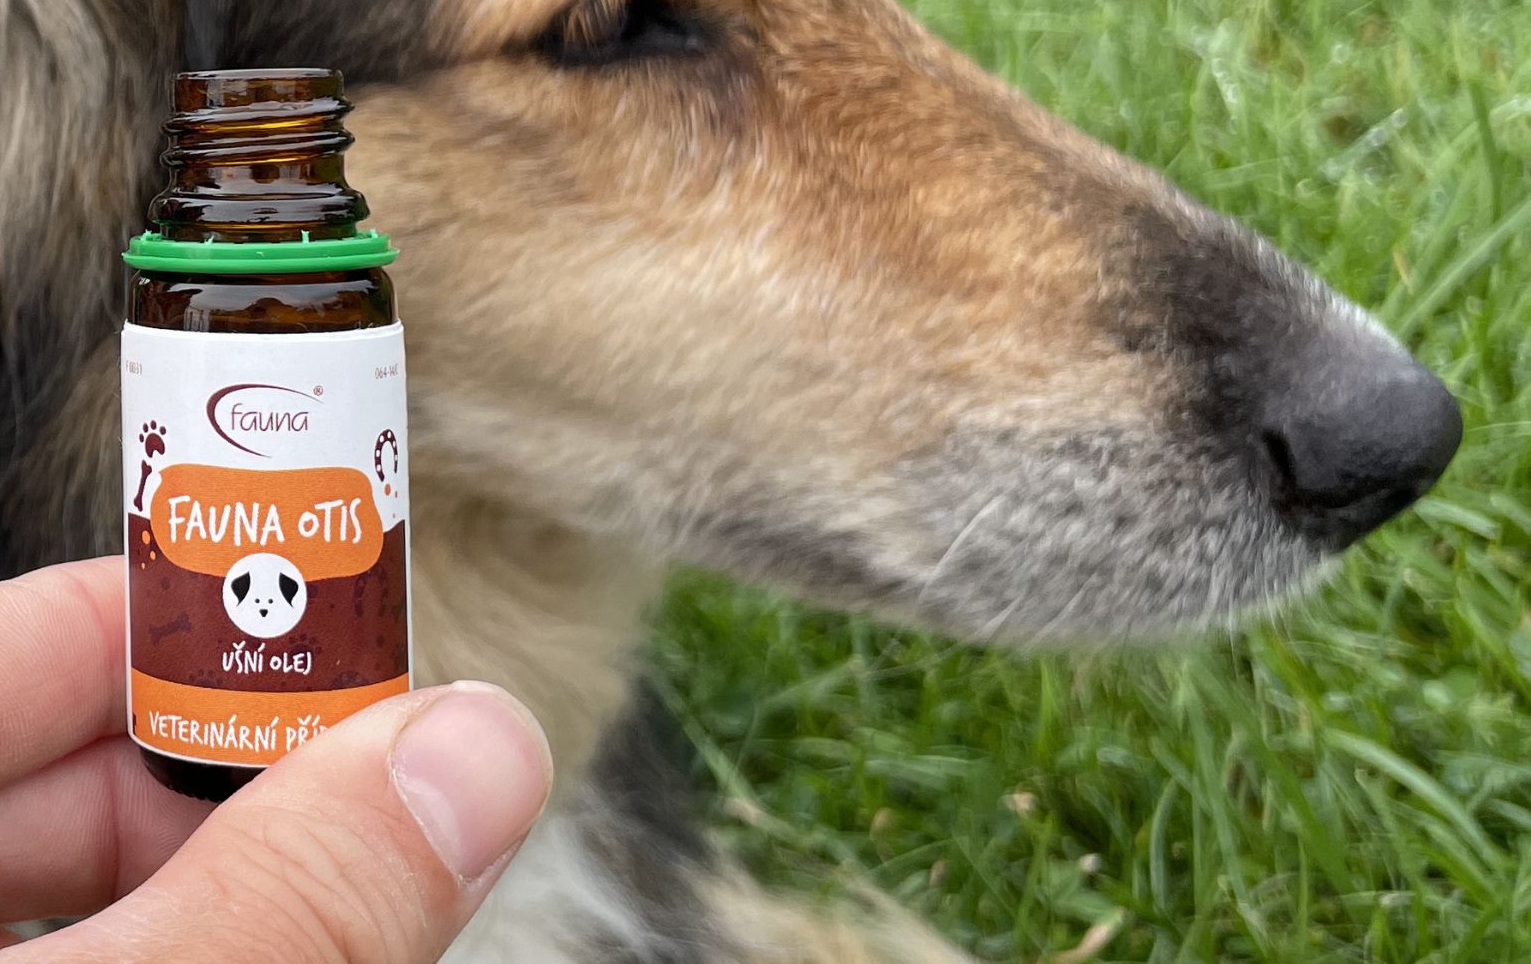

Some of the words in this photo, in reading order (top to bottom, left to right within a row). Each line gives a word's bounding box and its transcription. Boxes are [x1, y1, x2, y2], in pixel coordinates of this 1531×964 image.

[231, 403, 309, 431] fauna
[168, 495, 285, 547] FAUNA
[222, 640, 266, 674] UŠNÍ
[269, 651, 313, 675] OLEJ
[149, 711, 279, 753] VETERINÁRNÍ
